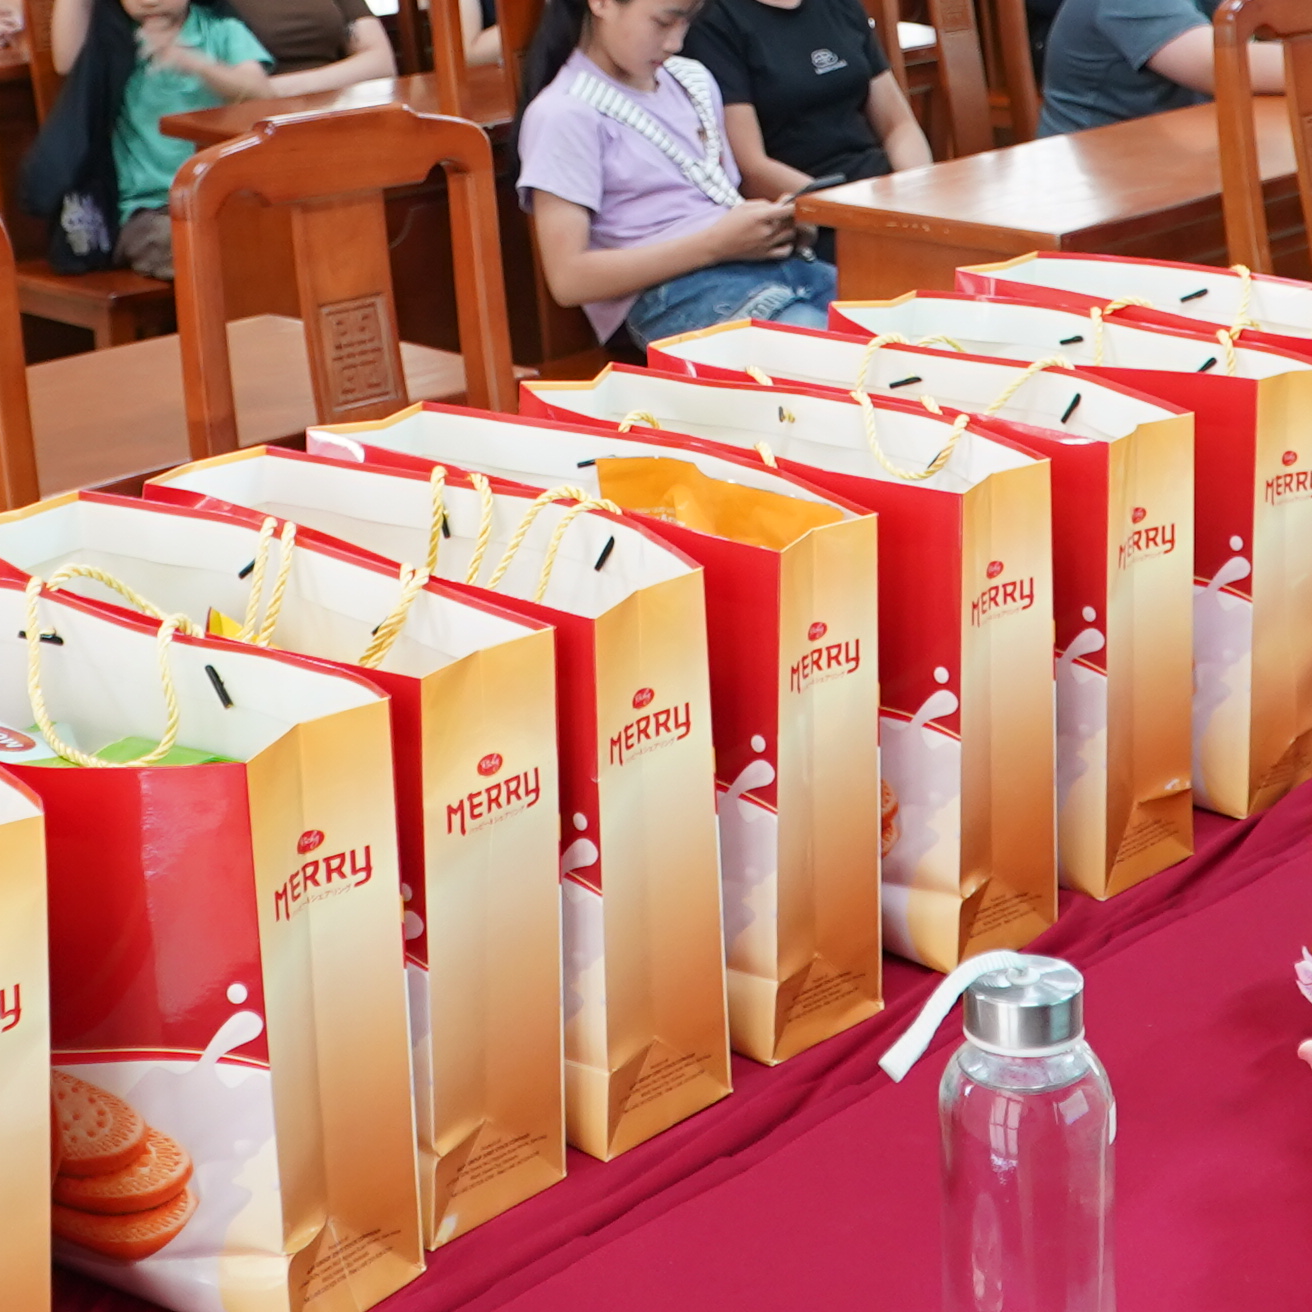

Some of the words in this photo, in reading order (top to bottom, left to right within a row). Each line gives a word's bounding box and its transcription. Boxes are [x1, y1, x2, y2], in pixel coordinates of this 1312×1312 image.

[971, 575, 1034, 628] MERRY
[790, 638, 860, 695] MERRY
[610, 701, 691, 767] MERRY
[446, 766, 540, 837] MERRY
[274, 844, 373, 923] MERRY
